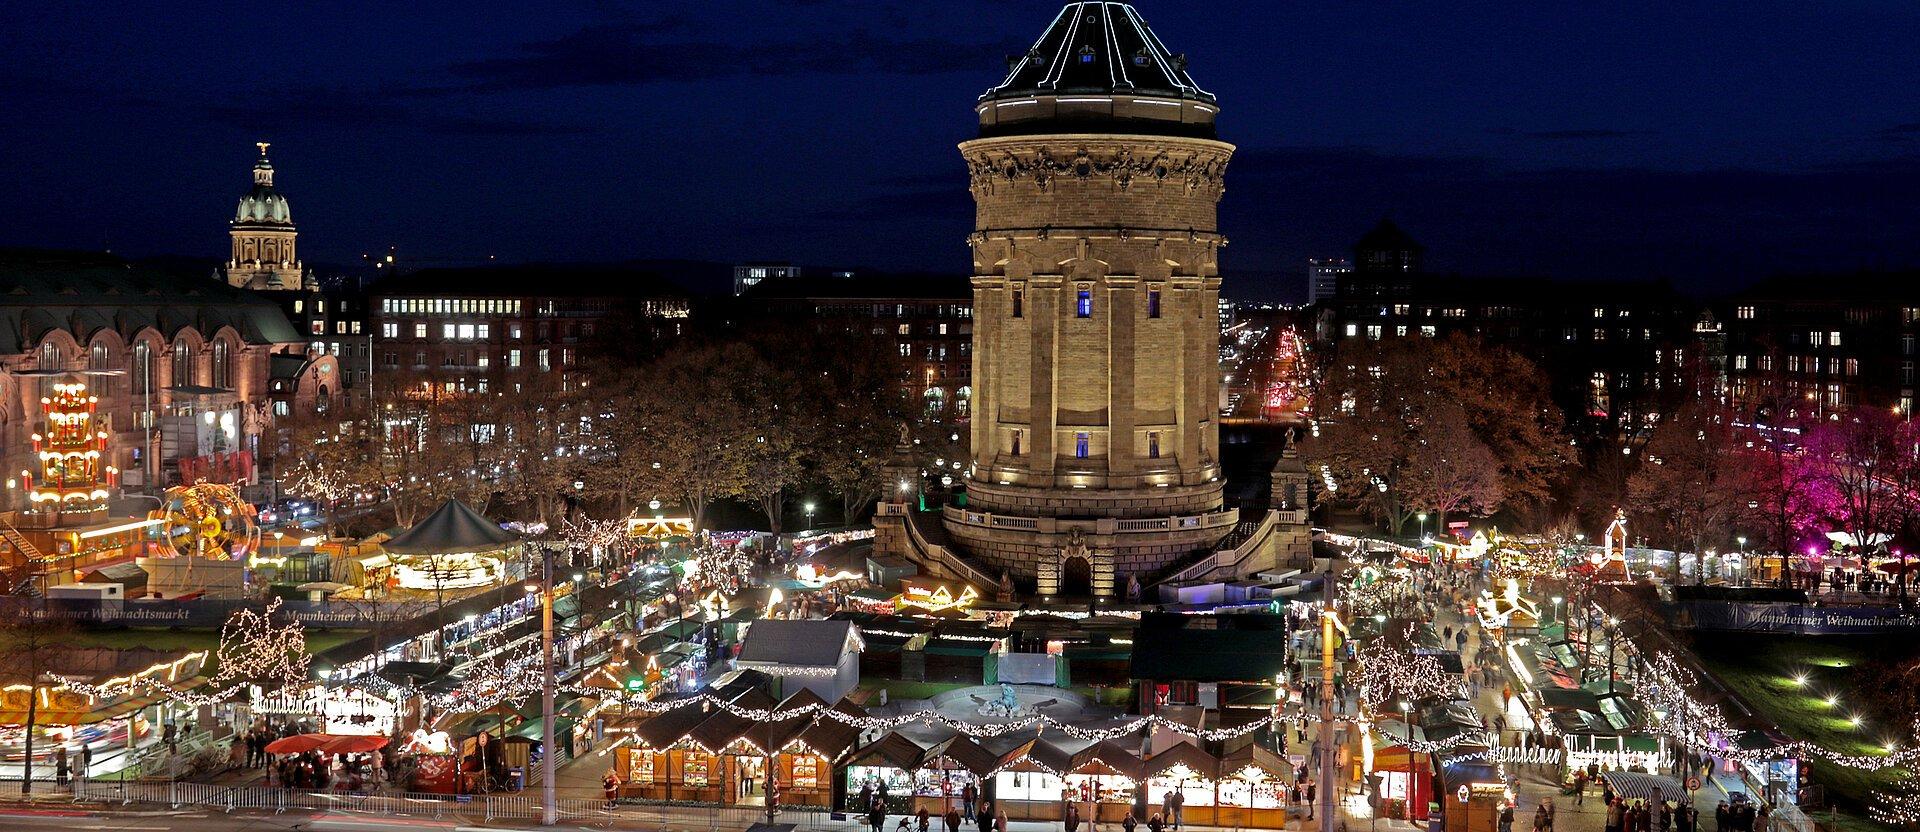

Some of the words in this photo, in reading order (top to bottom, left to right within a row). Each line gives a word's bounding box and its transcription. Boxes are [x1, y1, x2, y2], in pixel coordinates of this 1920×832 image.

[91, 607, 190, 620] Weihnachtsmarkt
[284, 609, 356, 622] Mannheimer
[1749, 613, 1823, 625] Mannheimer
[1484, 732, 1561, 765] Mannheimer
